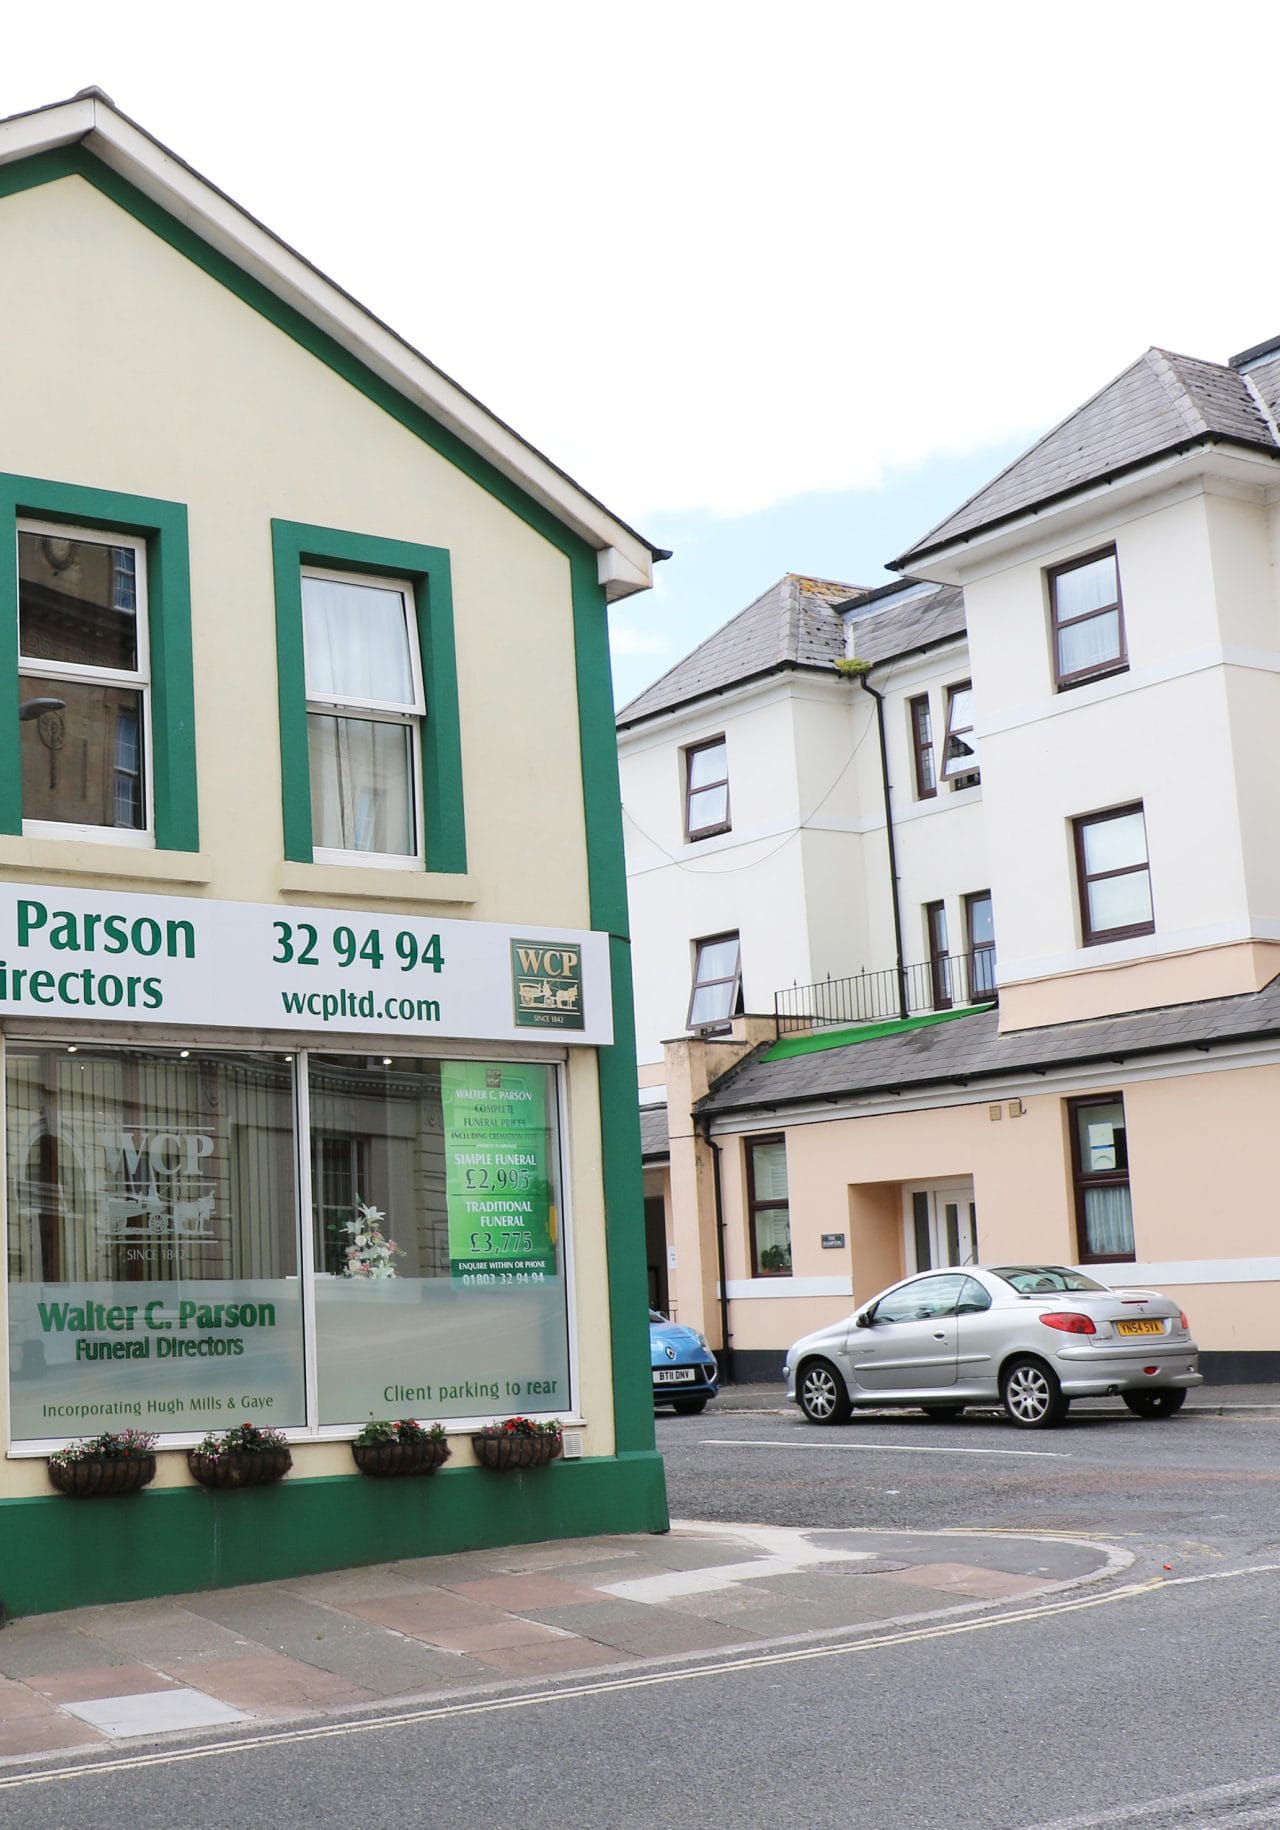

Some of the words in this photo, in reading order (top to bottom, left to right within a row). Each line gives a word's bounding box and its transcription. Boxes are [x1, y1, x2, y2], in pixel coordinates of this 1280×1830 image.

[17, 899, 196, 959] Parson
[272, 921, 320, 966] 32
[332, 925, 384, 970] 94
[395, 931, 445, 974] 94
[516, 948, 578, 977] WCP
[281, 988, 441, 1022] wcpltd.com
[455, 1089, 487, 1100] WALTER
[500, 1090, 532, 1101] PARSON
[474, 1104, 515, 1114] COMPLETE
[463, 1118, 499, 1127] FUNERAL
[451, 1132, 488, 1140] INCLUDING
[97, 1132, 215, 1176] WCP
[454, 1153, 493, 1165] SIMPLE
[495, 1154, 537, 1166] FUNERAL
[465, 1167, 530, 1192] £2,995
[465, 1201, 533, 1213] TRADITIONAL
[480, 1216, 525, 1227] FUNERAL
[470, 1231, 533, 1255] £3,775
[126, 1248, 157, 1260] SINCE
[458, 1262, 488, 1271] ENQUIRE
[489, 1261, 514, 1269] WITHIN
[514, 1261, 524, 1269] OR
[525, 1260, 546, 1269] PHONE
[462, 1274, 496, 1286] 01803
[499, 1273, 513, 1285] 32
[516, 1272, 529, 1284] 94
[531, 1271, 545, 1284] 94
[37, 1300, 138, 1332] Walter
[144, 1300, 172, 1330] C.
[179, 1301, 276, 1329] Parson
[1120, 1321, 1144, 1333] YN54
[1145, 1321, 1160, 1332] SVA
[75, 1336, 150, 1360] Funeral
[156, 1337, 244, 1358] Directors
[384, 1385, 432, 1402] Client
[439, 1381, 500, 1402] parking
[506, 1382, 521, 1396] to
[527, 1379, 558, 1395] rear
[43, 1401, 142, 1418] Incorporating
[147, 1399, 184, 1414] Hugh
[189, 1396, 222, 1411] Mills
[227, 1397, 236, 1408] &
[241, 1395, 274, 1409] Gaye
